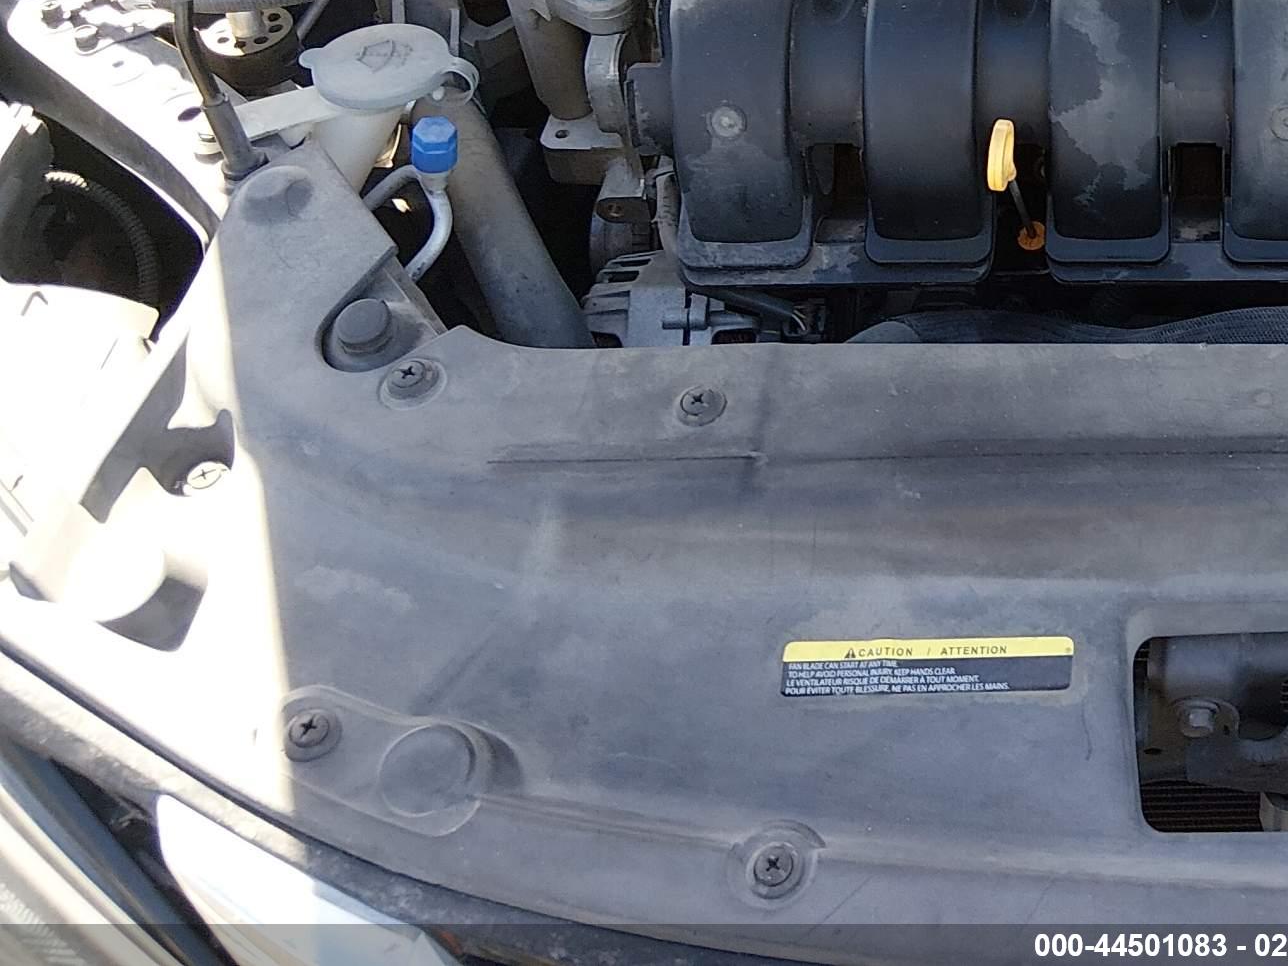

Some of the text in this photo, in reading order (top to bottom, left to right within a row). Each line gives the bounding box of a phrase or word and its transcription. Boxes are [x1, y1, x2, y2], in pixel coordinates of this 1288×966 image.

[858, 647, 913, 658] CAUTION
[940, 645, 1008, 656] ATTENTION
[798, 670, 815, 678] HELP
[837, 669, 869, 677] PERSONAL
[795, 678, 843, 686] VENTILATEUR
